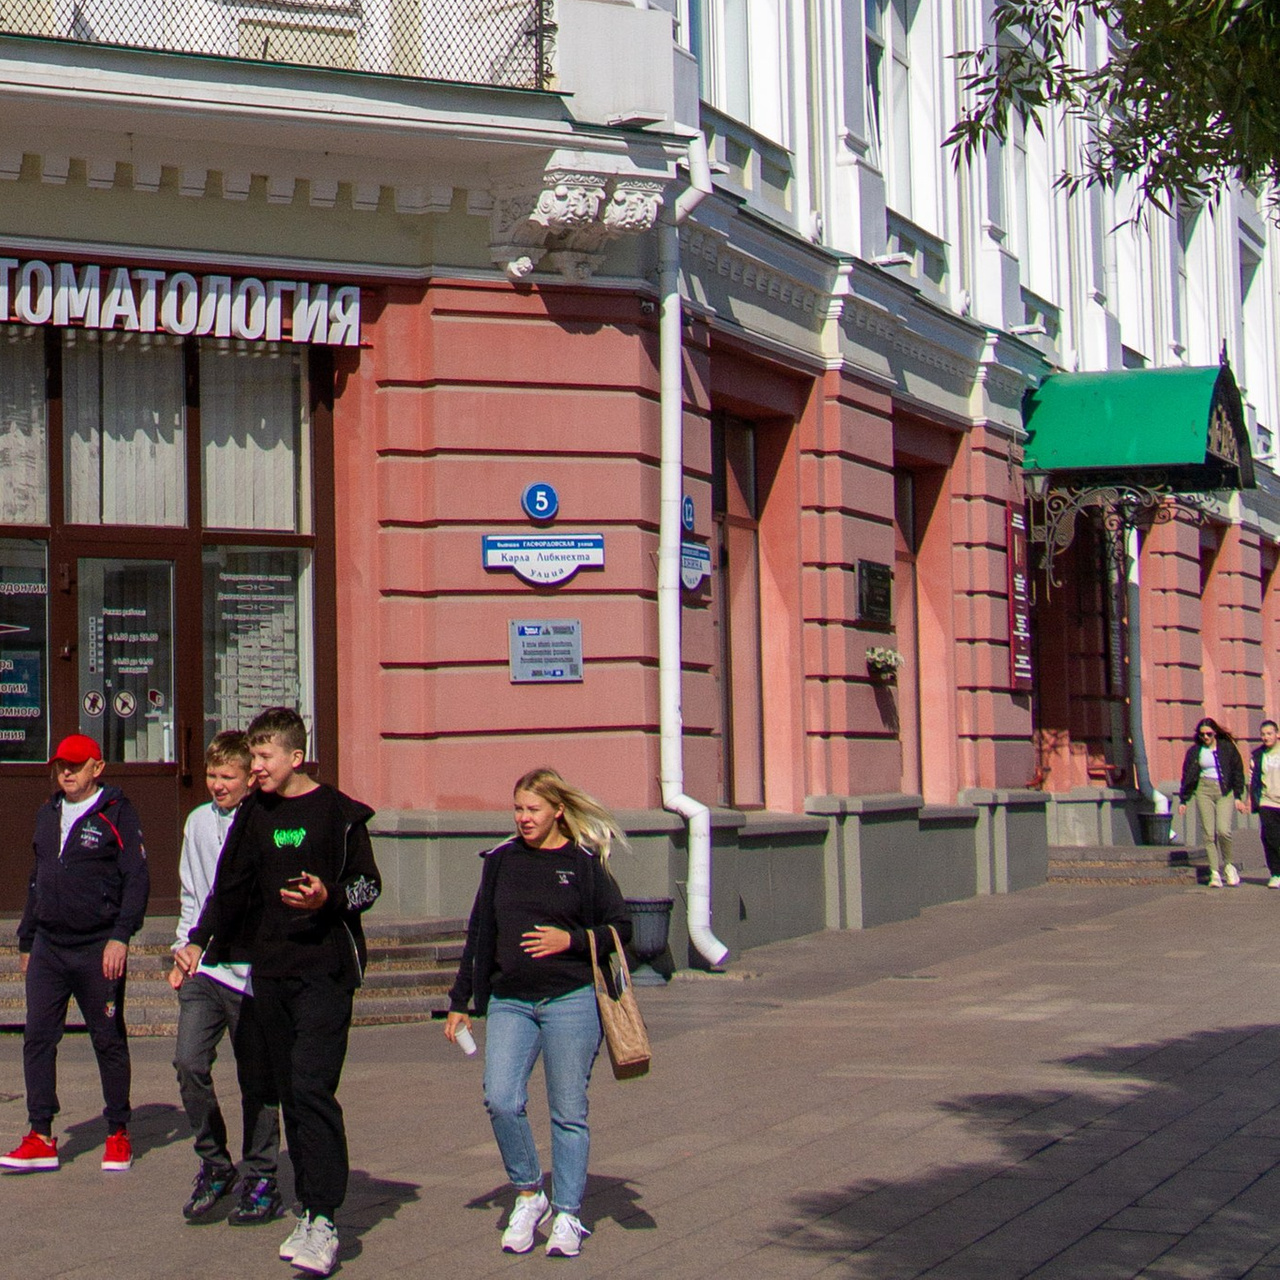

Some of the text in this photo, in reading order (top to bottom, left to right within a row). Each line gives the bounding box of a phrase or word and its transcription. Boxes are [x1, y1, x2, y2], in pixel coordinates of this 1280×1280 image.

[535, 490, 549, 511] 5
[685, 503, 693, 522] 12
[501, 552, 591, 564] Карла Либкнехта
[530, 567, 565, 579] улица
